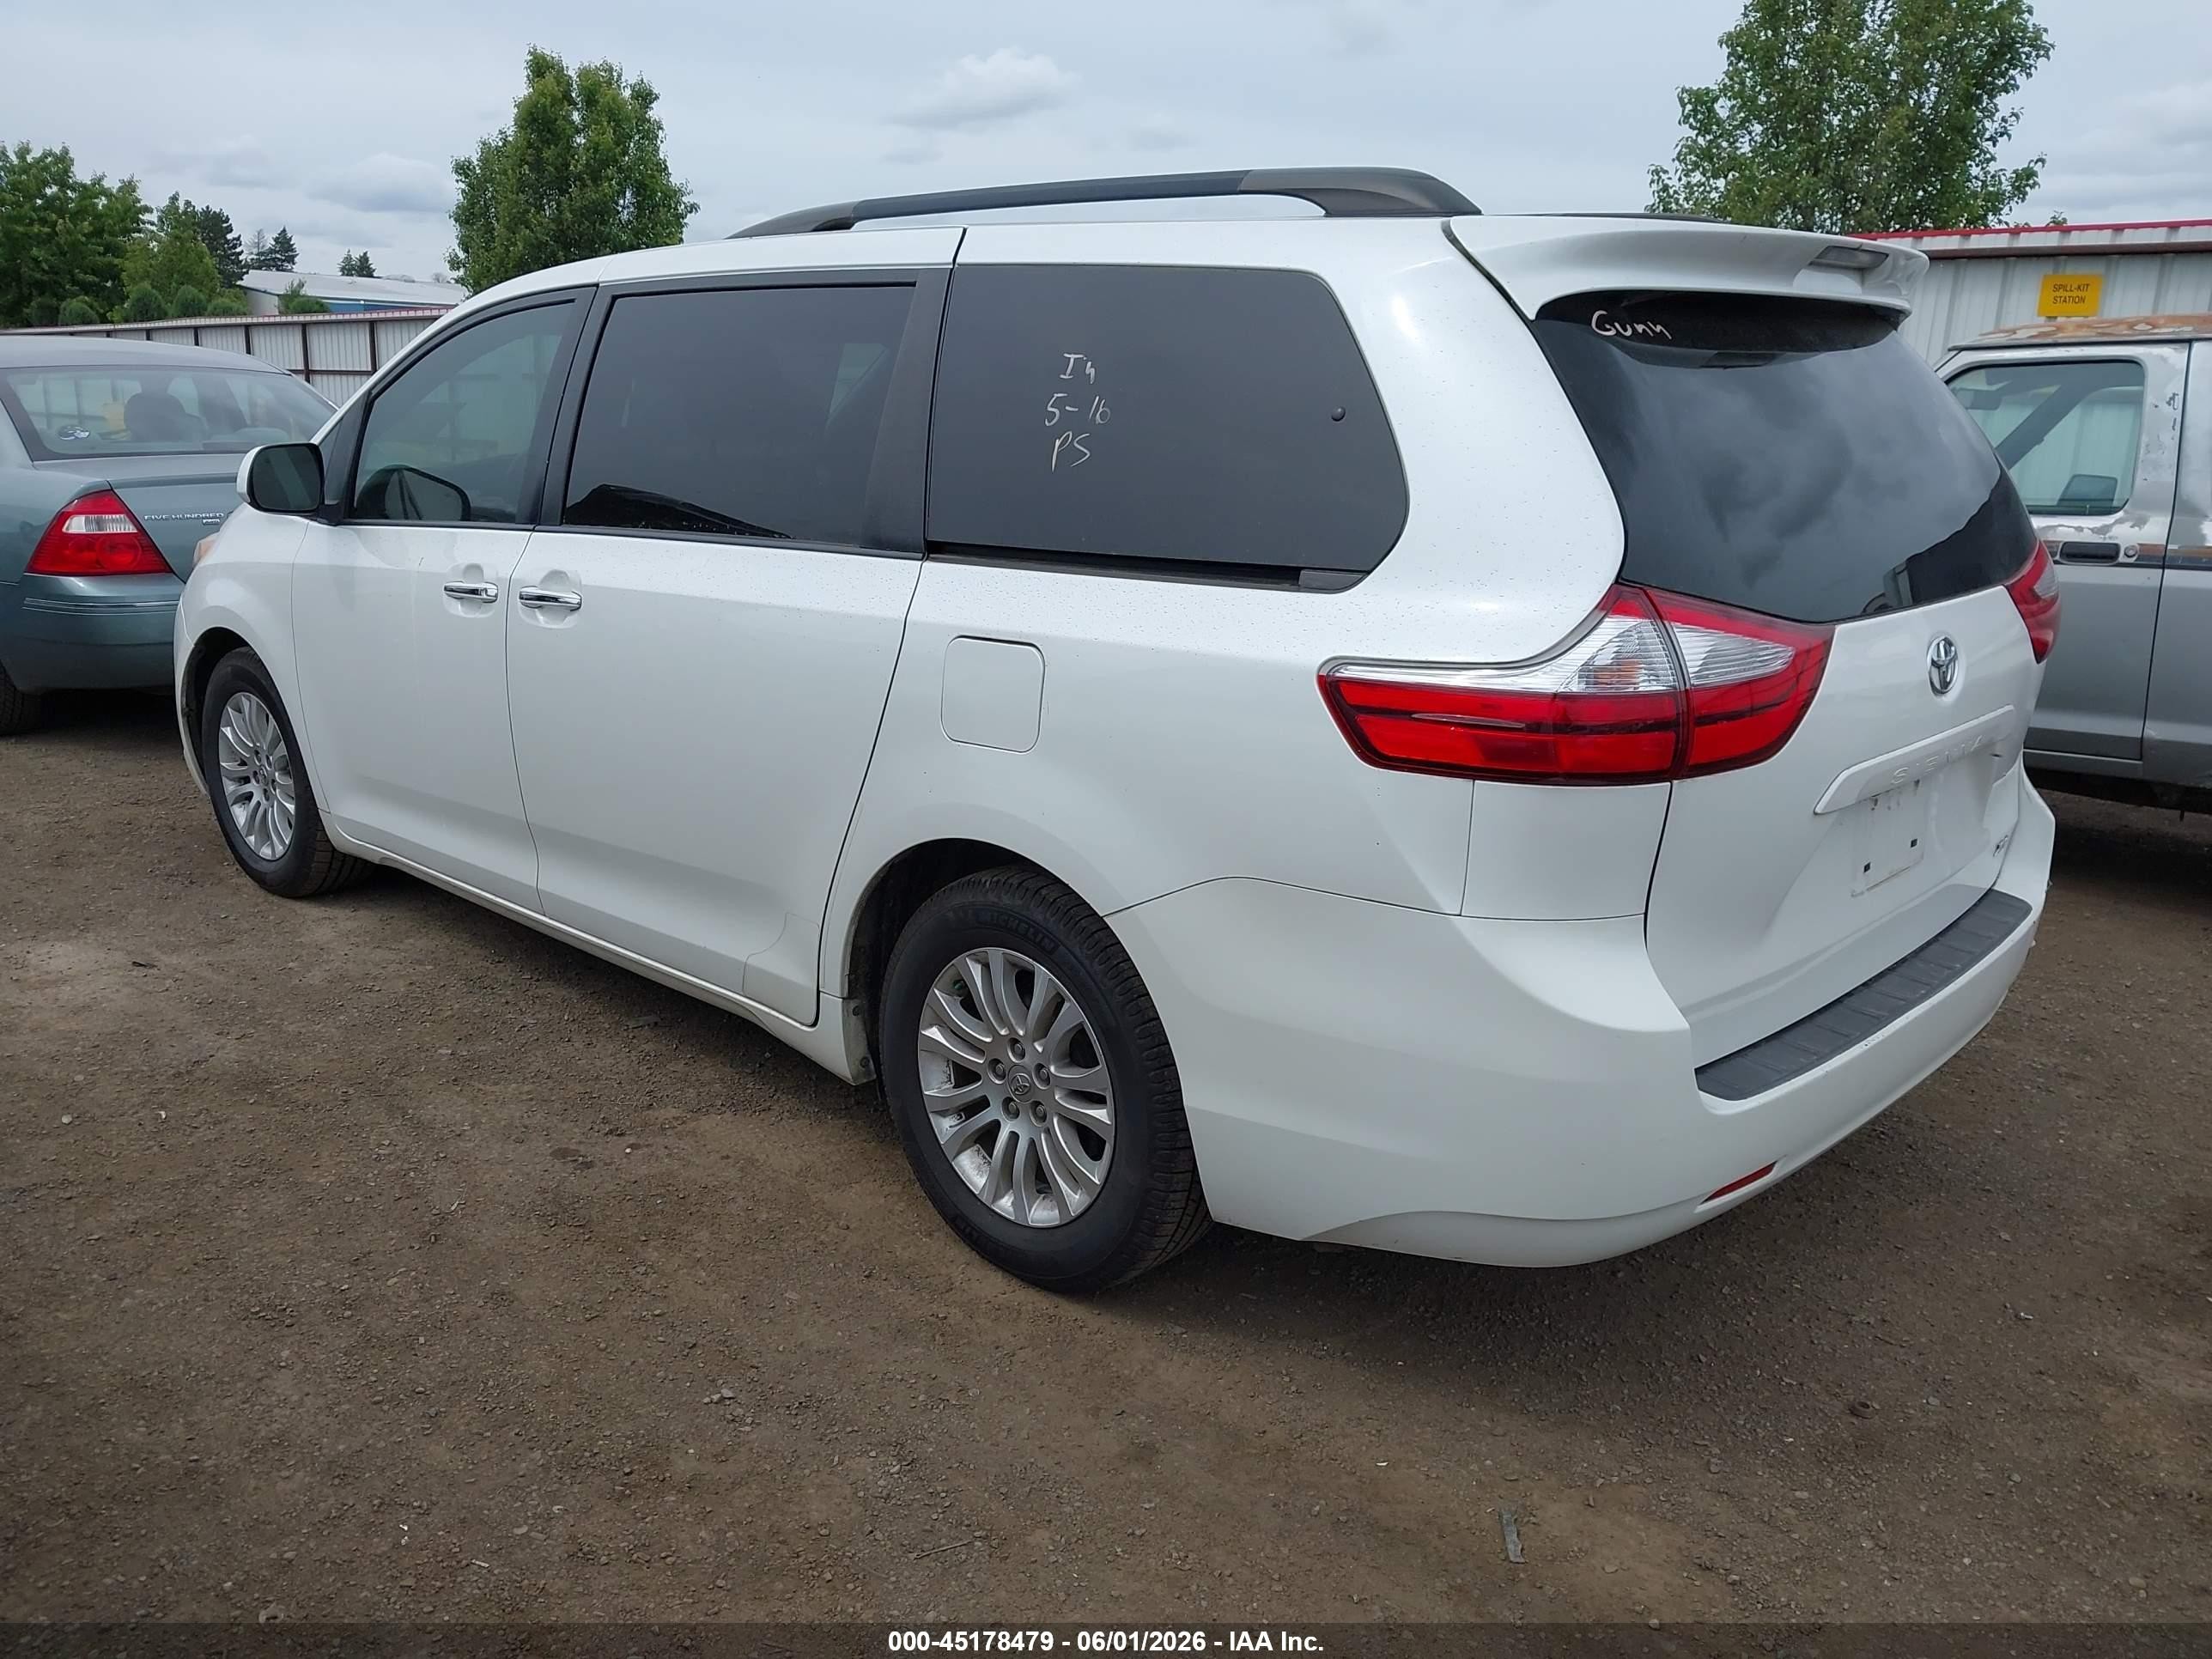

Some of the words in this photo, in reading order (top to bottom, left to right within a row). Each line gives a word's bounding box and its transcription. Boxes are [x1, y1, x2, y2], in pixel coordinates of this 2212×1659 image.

[2052, 283, 2090, 293] SPILL-KIT
[2052, 295, 2086, 305] STATION
[1051, 430, 1091, 472] PS
